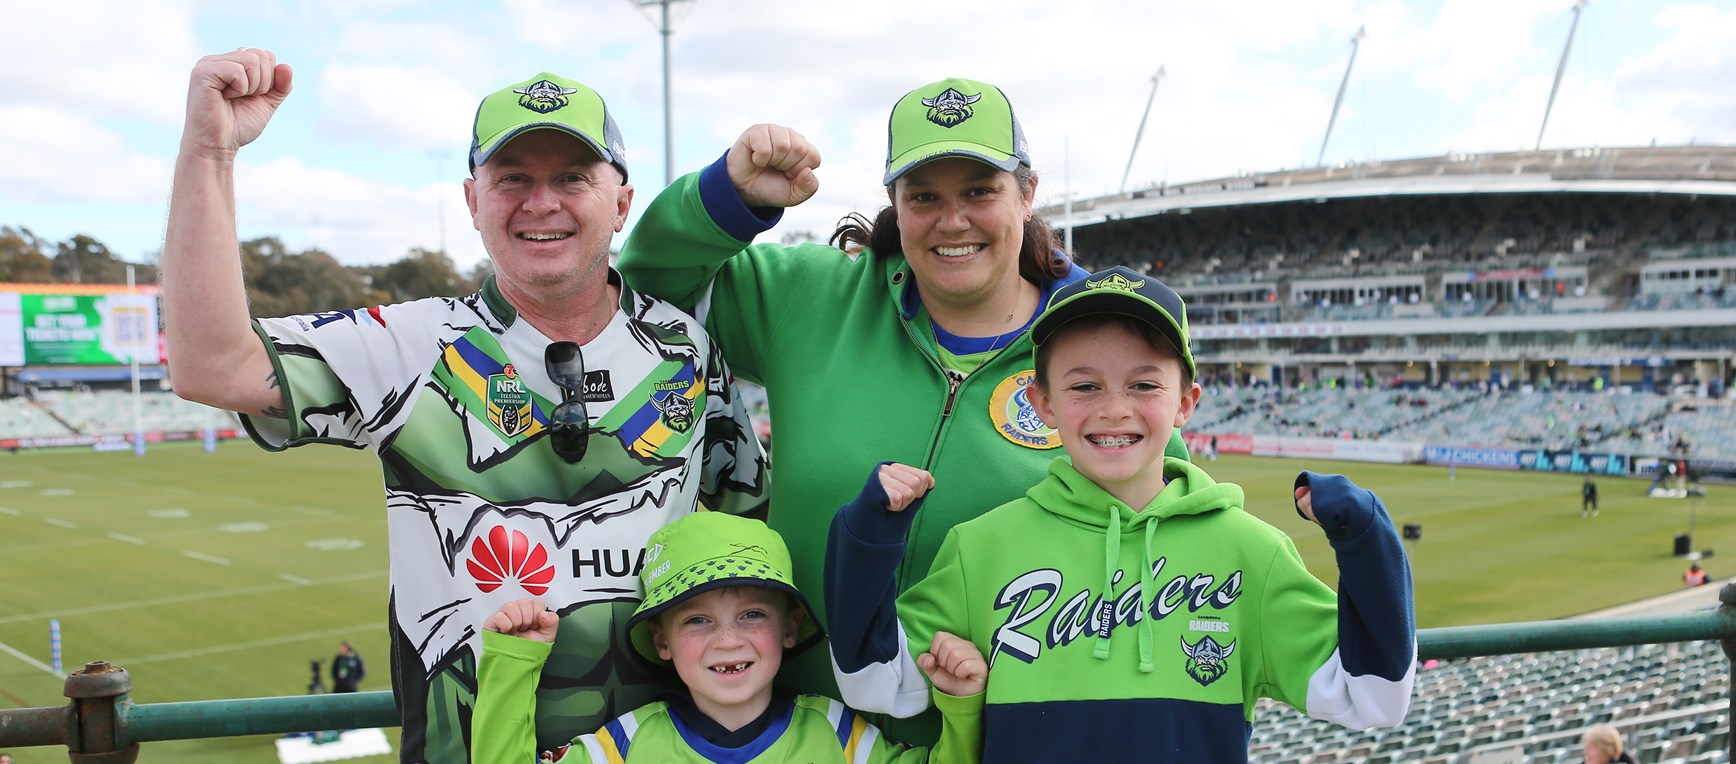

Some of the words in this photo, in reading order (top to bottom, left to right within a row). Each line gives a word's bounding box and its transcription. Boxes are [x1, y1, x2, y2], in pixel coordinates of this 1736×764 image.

[496, 380, 526, 394] NRL
[655, 381, 690, 391] RAIDERS
[1001, 423, 1049, 446] RAIDERS
[989, 556, 1243, 671] Raiders
[1099, 603, 1112, 637] RAIDERS
[1188, 620, 1230, 633] RAIDERS
